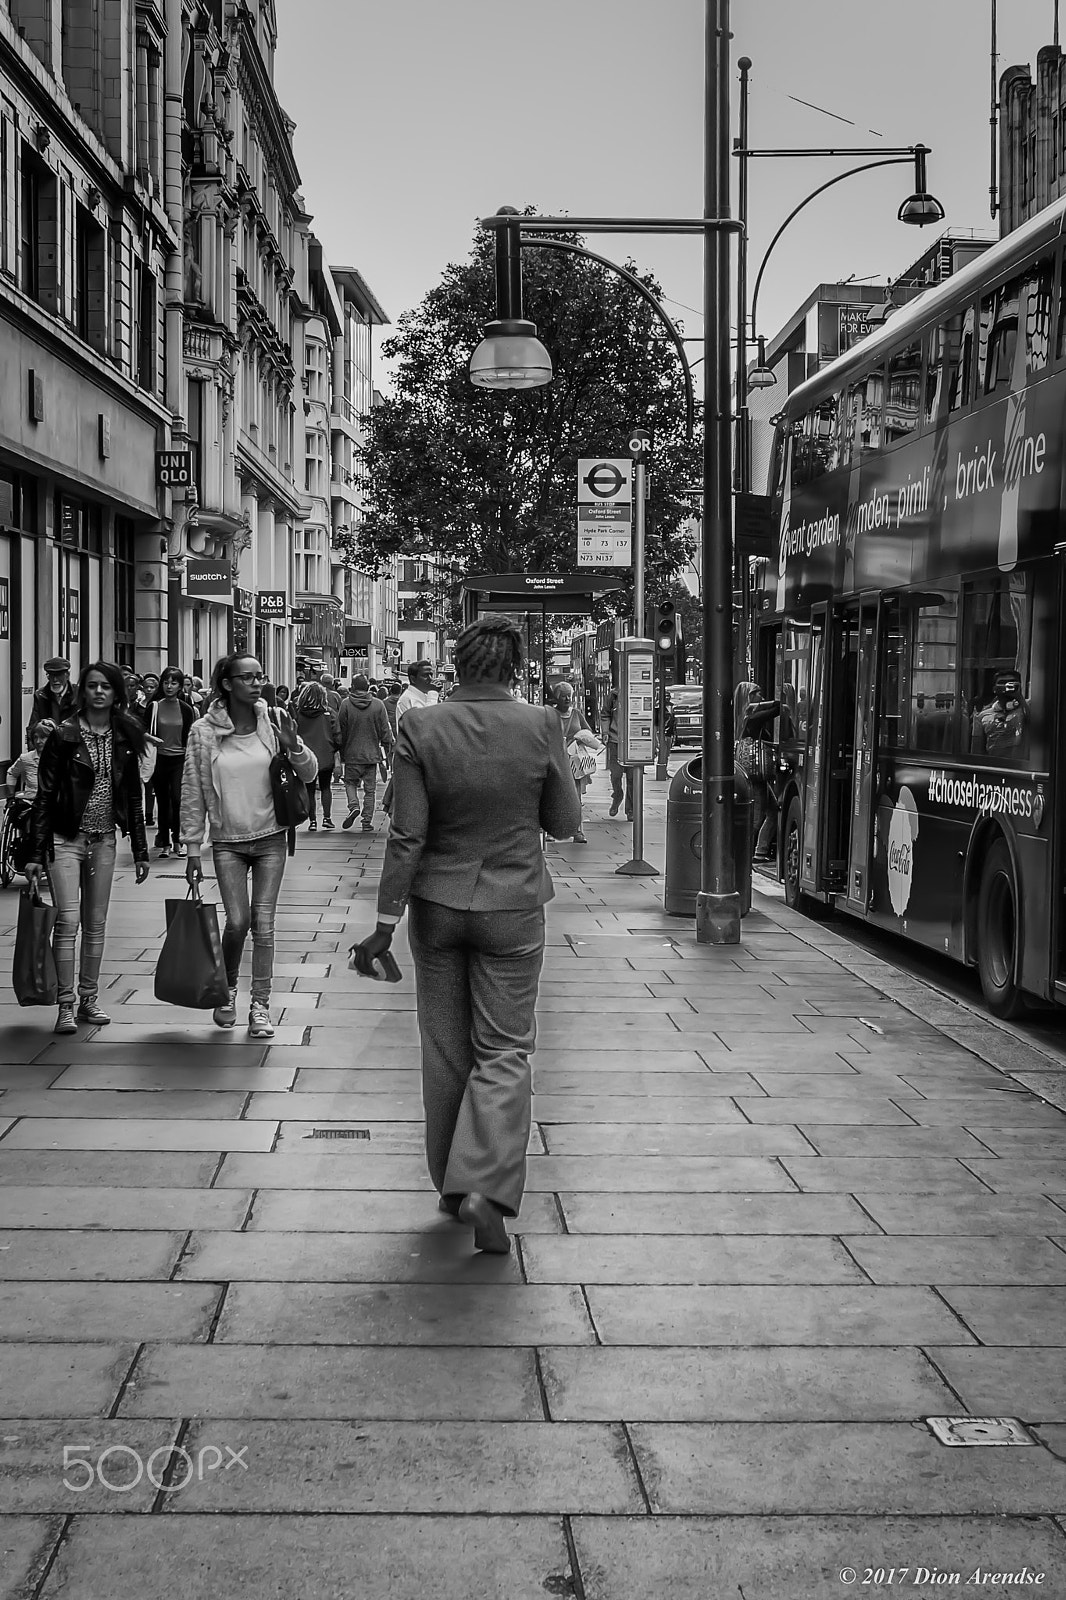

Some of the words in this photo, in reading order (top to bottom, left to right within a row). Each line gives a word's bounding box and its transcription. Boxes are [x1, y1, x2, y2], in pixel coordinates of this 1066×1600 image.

[841, 311, 867, 322] MAKE
[841, 323, 858, 333] FOR
[628, 438, 652, 452] OR
[806, 507, 840, 557] garden,
[955, 439, 997, 500] brick
[260, 595, 284, 608] P&B
[341, 648, 367, 658] next
[928, 770, 1032, 818] #choosehappiness
